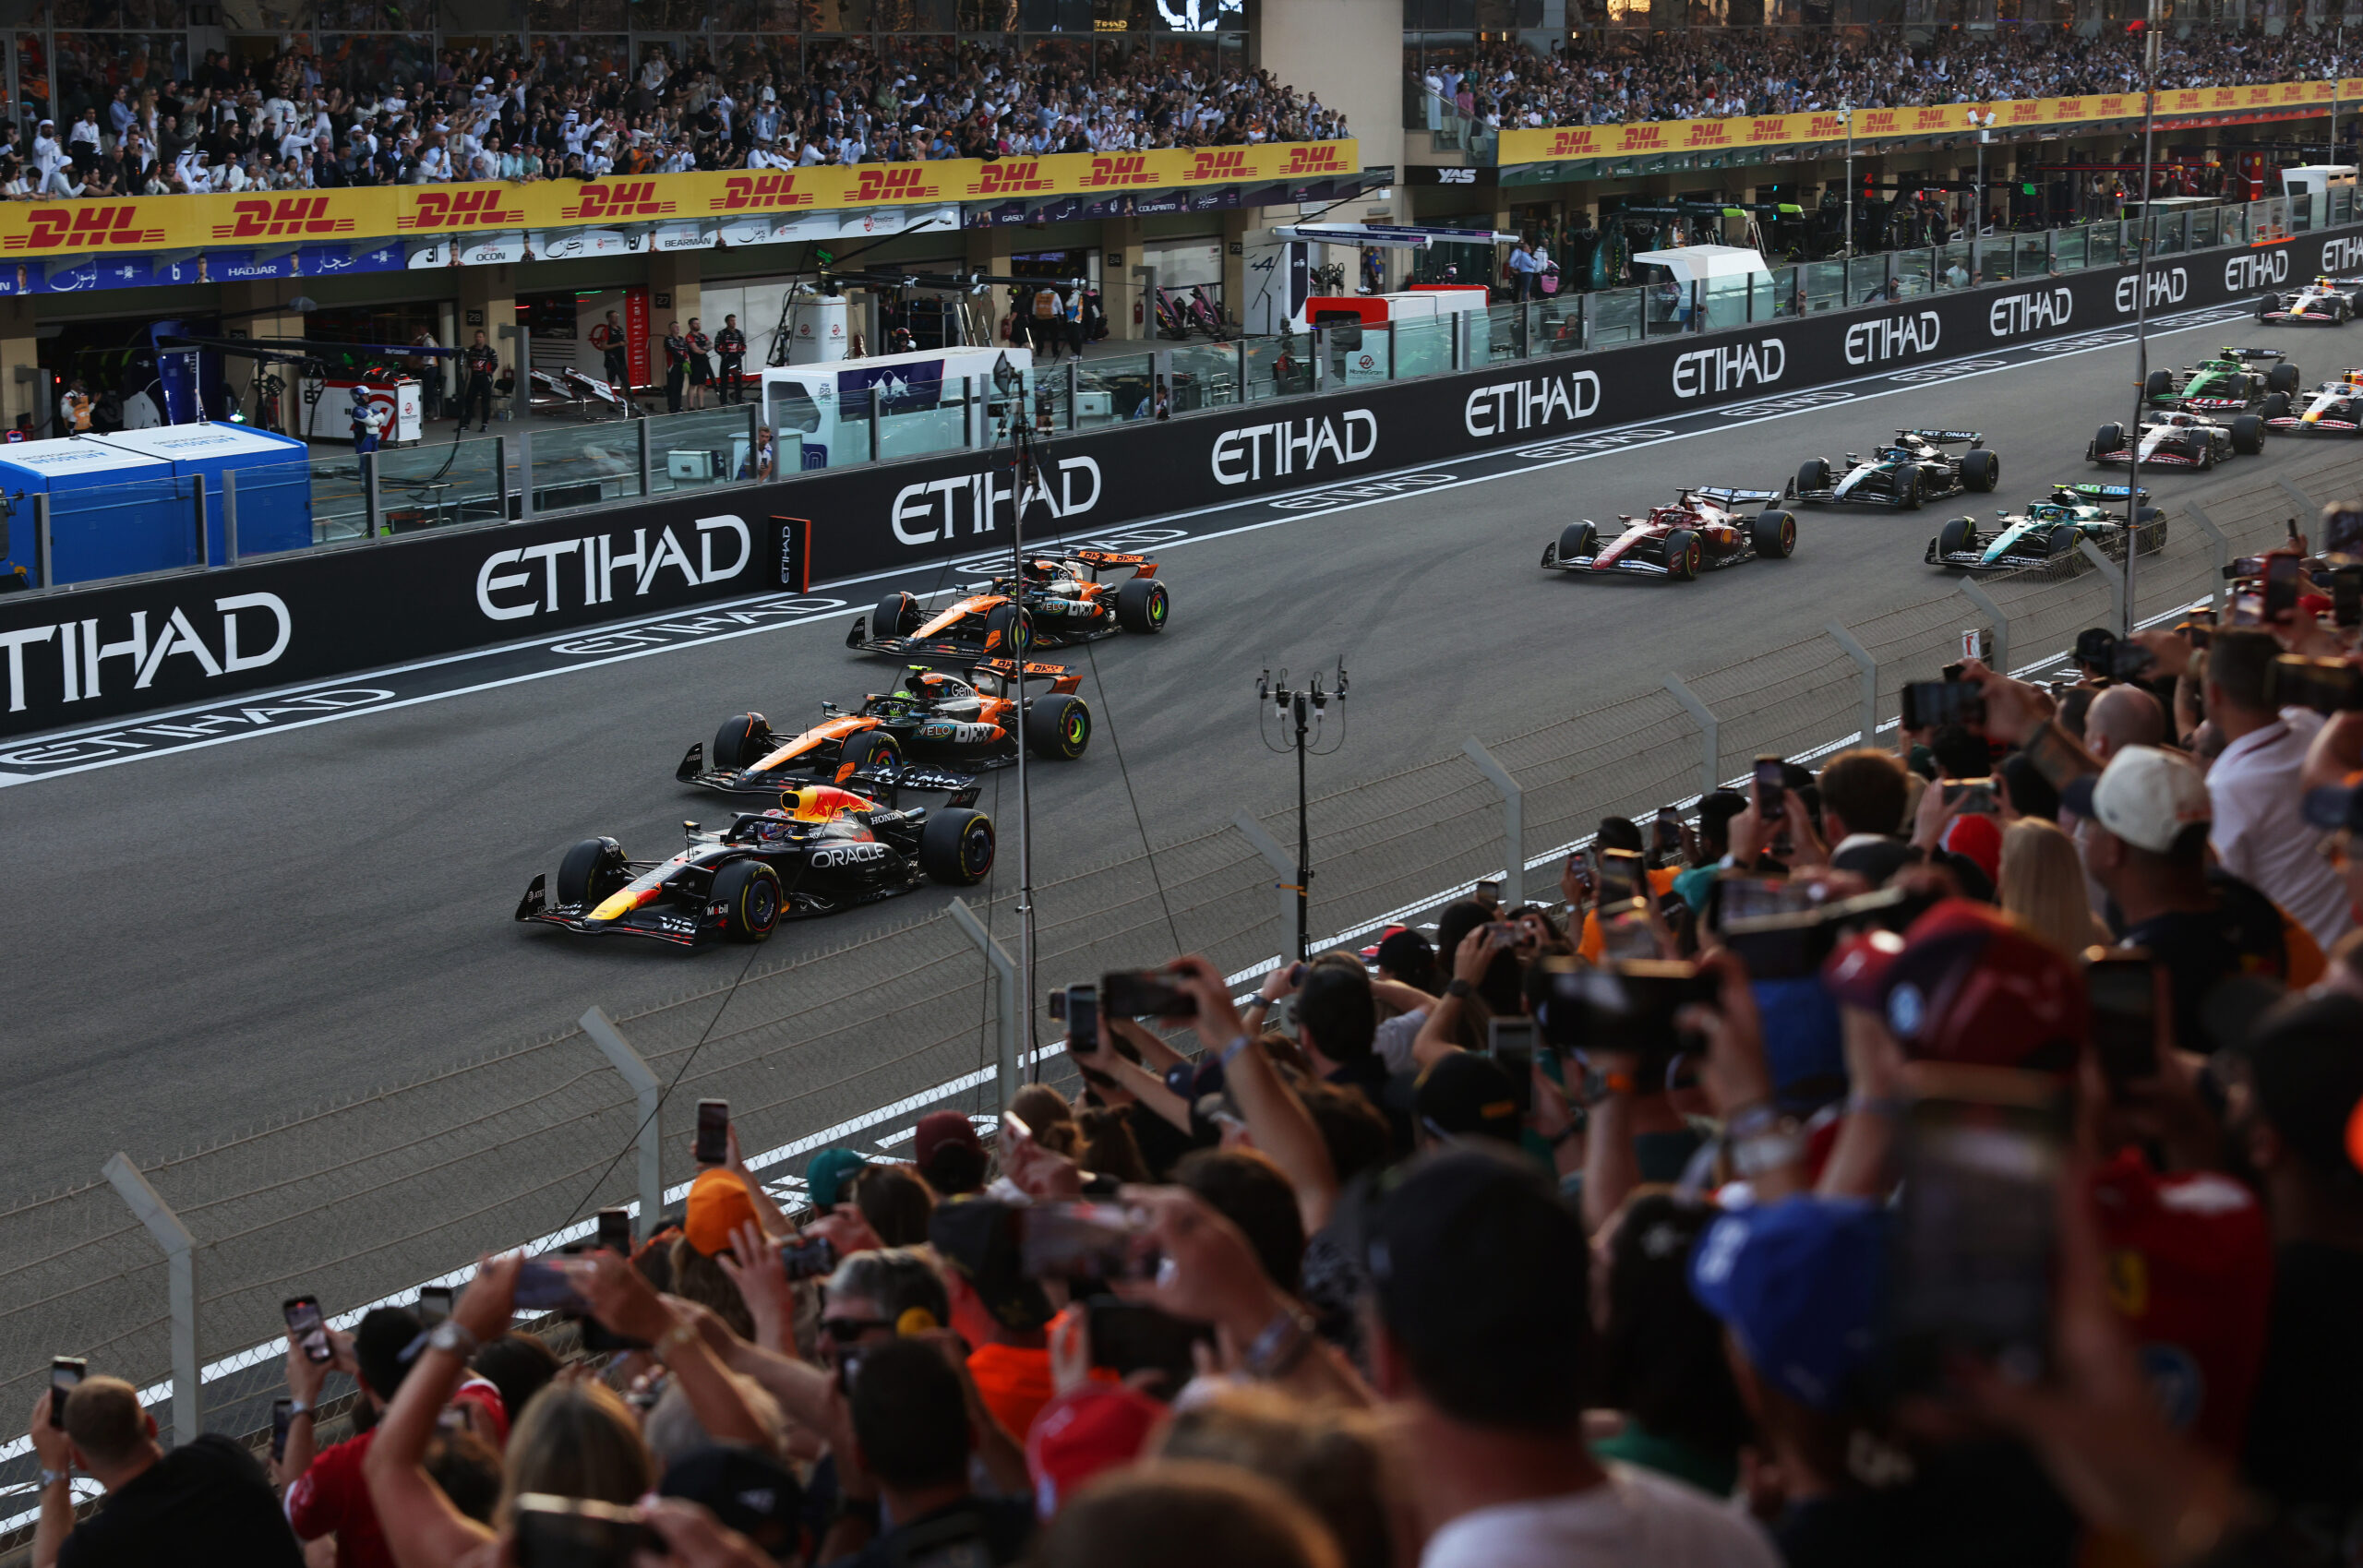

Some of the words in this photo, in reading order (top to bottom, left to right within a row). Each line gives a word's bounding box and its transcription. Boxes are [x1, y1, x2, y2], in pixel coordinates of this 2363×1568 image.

[2013, 103, 2038, 122] DHL
[2057, 101, 2081, 119] DHL
[2100, 98, 2123, 115] DHL
[2178, 93, 2199, 109] DHL
[1753, 119, 1785, 141] DHL
[1865, 113, 1894, 133] DHL
[1918, 110, 1944, 129] DHL
[1554, 131, 1594, 155] DHL
[1624, 126, 1662, 150] DHL
[1690, 124, 1725, 146] DHL
[1090, 156, 1149, 186] DHL
[1193, 150, 1248, 179] DHL
[1289, 146, 1339, 174] DHL
[858, 168, 927, 201] DHL
[978, 162, 1042, 194] DHL
[1437, 168, 1477, 184] YAS
[578, 182, 662, 218] DHL
[725, 174, 800, 209] DHL
[233, 197, 336, 237] DHL
[415, 189, 508, 228] DHL
[1002, 213, 1025, 222] GASLY
[1137, 202, 1176, 213] COLAPINTO
[27, 206, 145, 248] DHL
[665, 236, 712, 248] BEARMAN
[476, 252, 506, 262] OCON
[228, 265, 277, 277] HADJAR
[2225, 250, 2289, 292] ETIHAD
[2115, 267, 2188, 313] ETHAD
[468, 312, 481, 323] 28
[1990, 287, 2073, 337] ETIHAD
[1845, 311, 1940, 365] ETIHAD
[1673, 338, 1785, 399] ETIHAD
[1465, 370, 1601, 437] ETIHAD
[1719, 391, 1856, 417] ETIHAD
[1516, 428, 1676, 459] ETIHAD
[1921, 430, 1972, 438] PETONAS
[1211, 409, 1378, 485] ETIHAD
[1268, 473, 1458, 509] ETIHAD
[475, 513, 751, 621] ETIHAD
[780, 525, 791, 584] ETIHAD
[1039, 602, 1065, 612] VELO
[550, 598, 847, 654] ETIHAD
[0, 688, 396, 765] ETIHAD
[918, 725, 951, 736] VELO
[870, 809, 904, 825] HONDA
[811, 843, 885, 868] ORACLE
[534, 889, 545, 899] AT&T
[706, 904, 729, 916] Mobil
